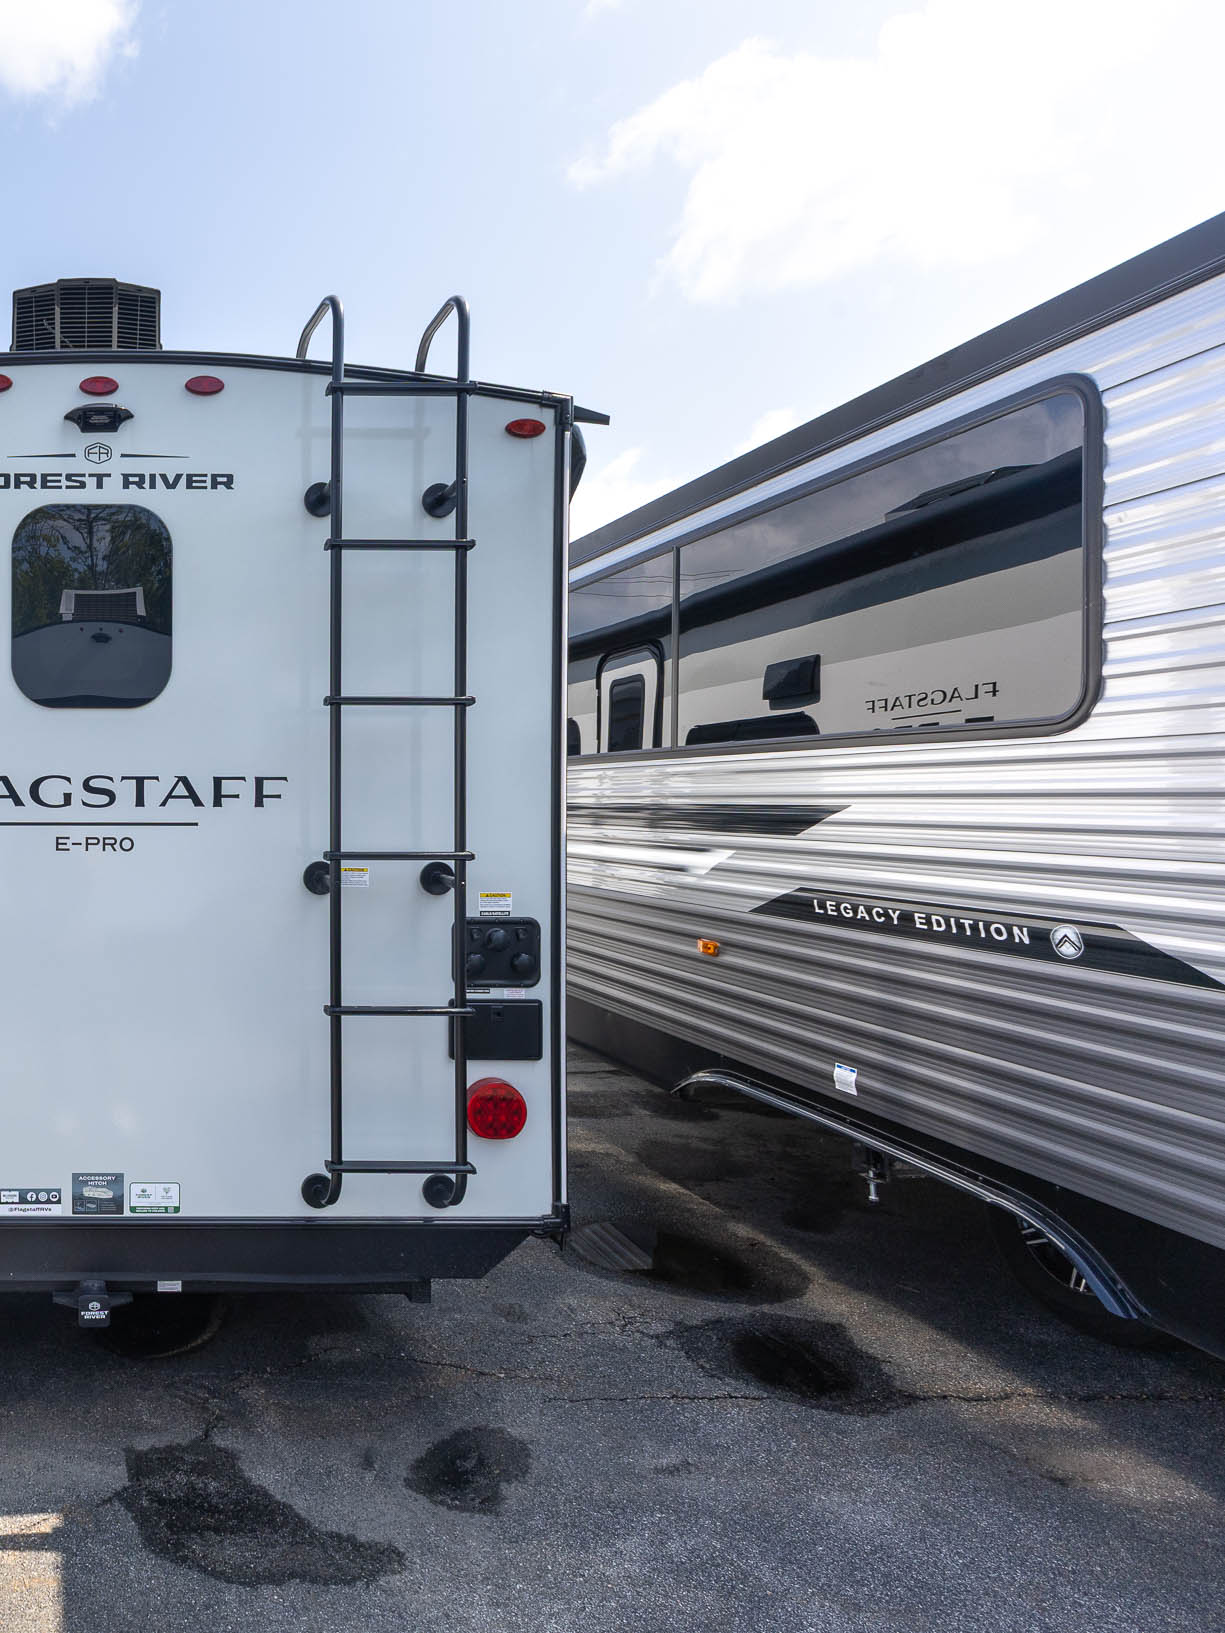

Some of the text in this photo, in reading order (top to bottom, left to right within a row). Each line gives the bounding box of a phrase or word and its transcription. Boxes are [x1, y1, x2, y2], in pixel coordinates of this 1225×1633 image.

[120, 472, 235, 490] RIVER
[55, 836, 135, 852] E-PRO
[813, 899, 1031, 945] LEGACY EDITION
